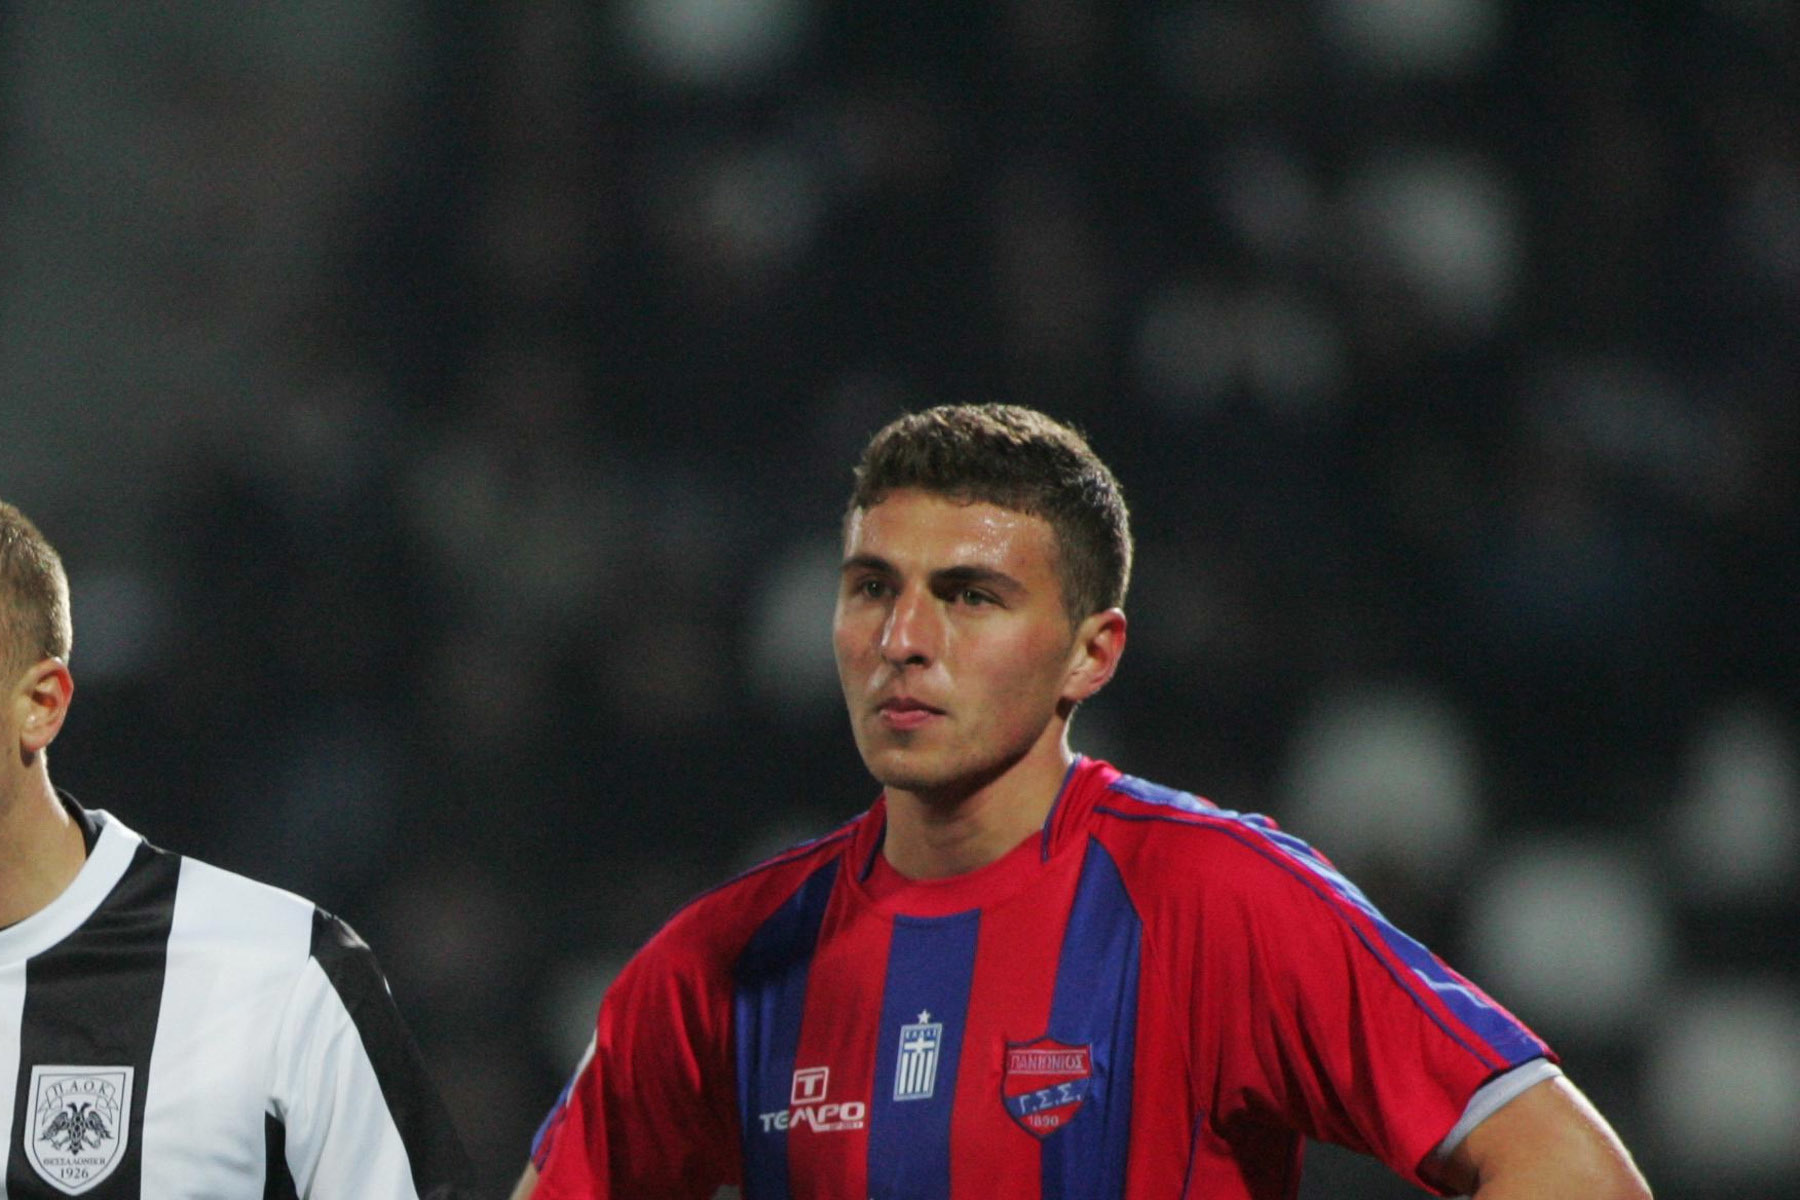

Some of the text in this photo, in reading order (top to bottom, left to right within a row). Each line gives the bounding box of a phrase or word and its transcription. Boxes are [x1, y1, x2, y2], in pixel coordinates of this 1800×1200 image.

[759, 1101, 865, 1133] TEMPO
[1027, 1115, 1060, 1127] 1890
[59, 1167, 89, 1180] 1926
